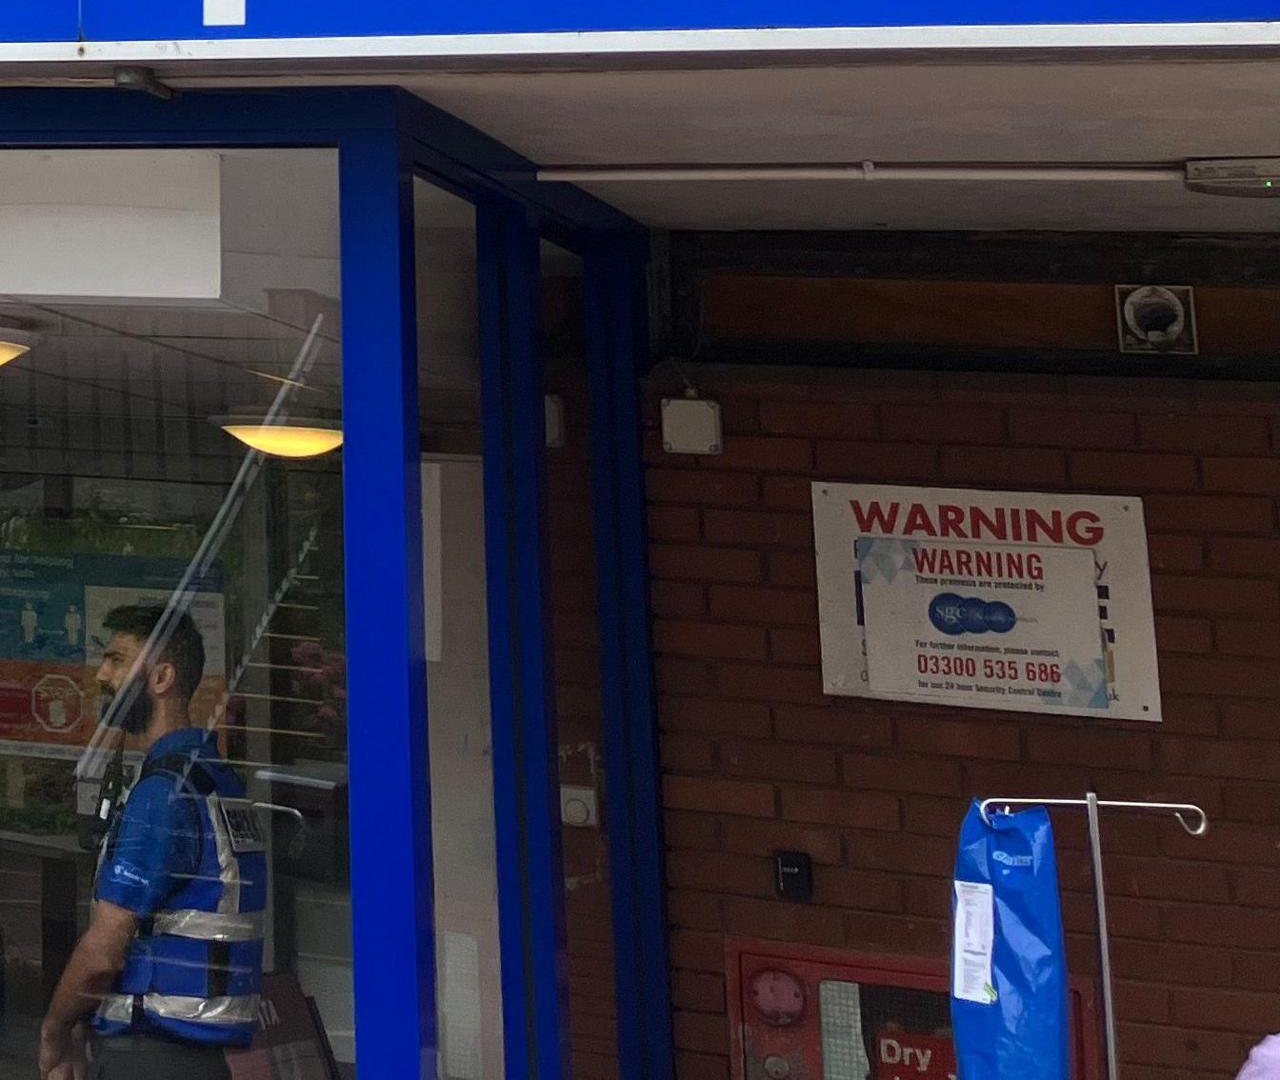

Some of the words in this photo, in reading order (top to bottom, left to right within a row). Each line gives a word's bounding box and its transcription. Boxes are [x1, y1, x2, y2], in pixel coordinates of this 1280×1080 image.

[848, 499, 1105, 547] WARNING
[911, 548, 1044, 581] WARNING
[994, 581, 1033, 591] protected
[1035, 583, 1045, 593] by
[917, 654, 977, 678] 03300
[983, 659, 1019, 681] 535
[1025, 662, 1062, 684] 686
[975, 684, 1006, 695] Security
[1008, 686, 1035, 696] Control
[880, 1038, 932, 1072] Dry
